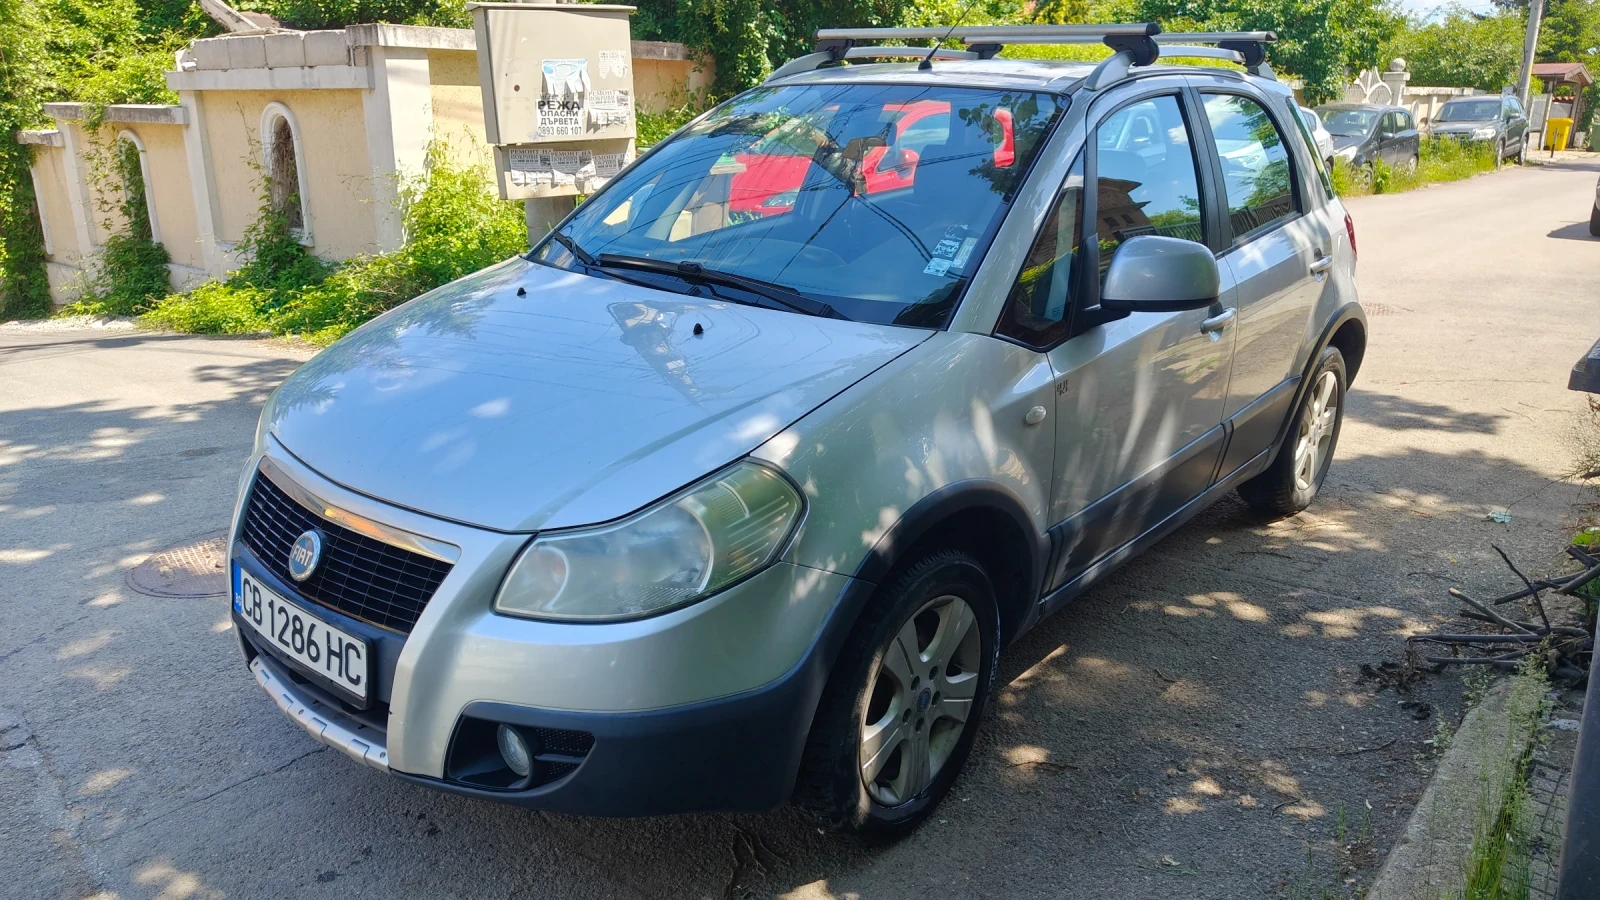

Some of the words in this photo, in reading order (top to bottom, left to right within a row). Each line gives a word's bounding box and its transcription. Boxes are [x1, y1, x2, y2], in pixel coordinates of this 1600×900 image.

[538, 100, 581, 110] РЕЖА
[540, 118, 579, 126] ДЪРВЕТА
[556, 126, 568, 135] 660
[571, 126, 582, 135] 107
[291, 545, 313, 567] FIAT
[243, 577, 263, 626] CB
[268, 599, 320, 663] 1286
[326, 630, 361, 686] HC
